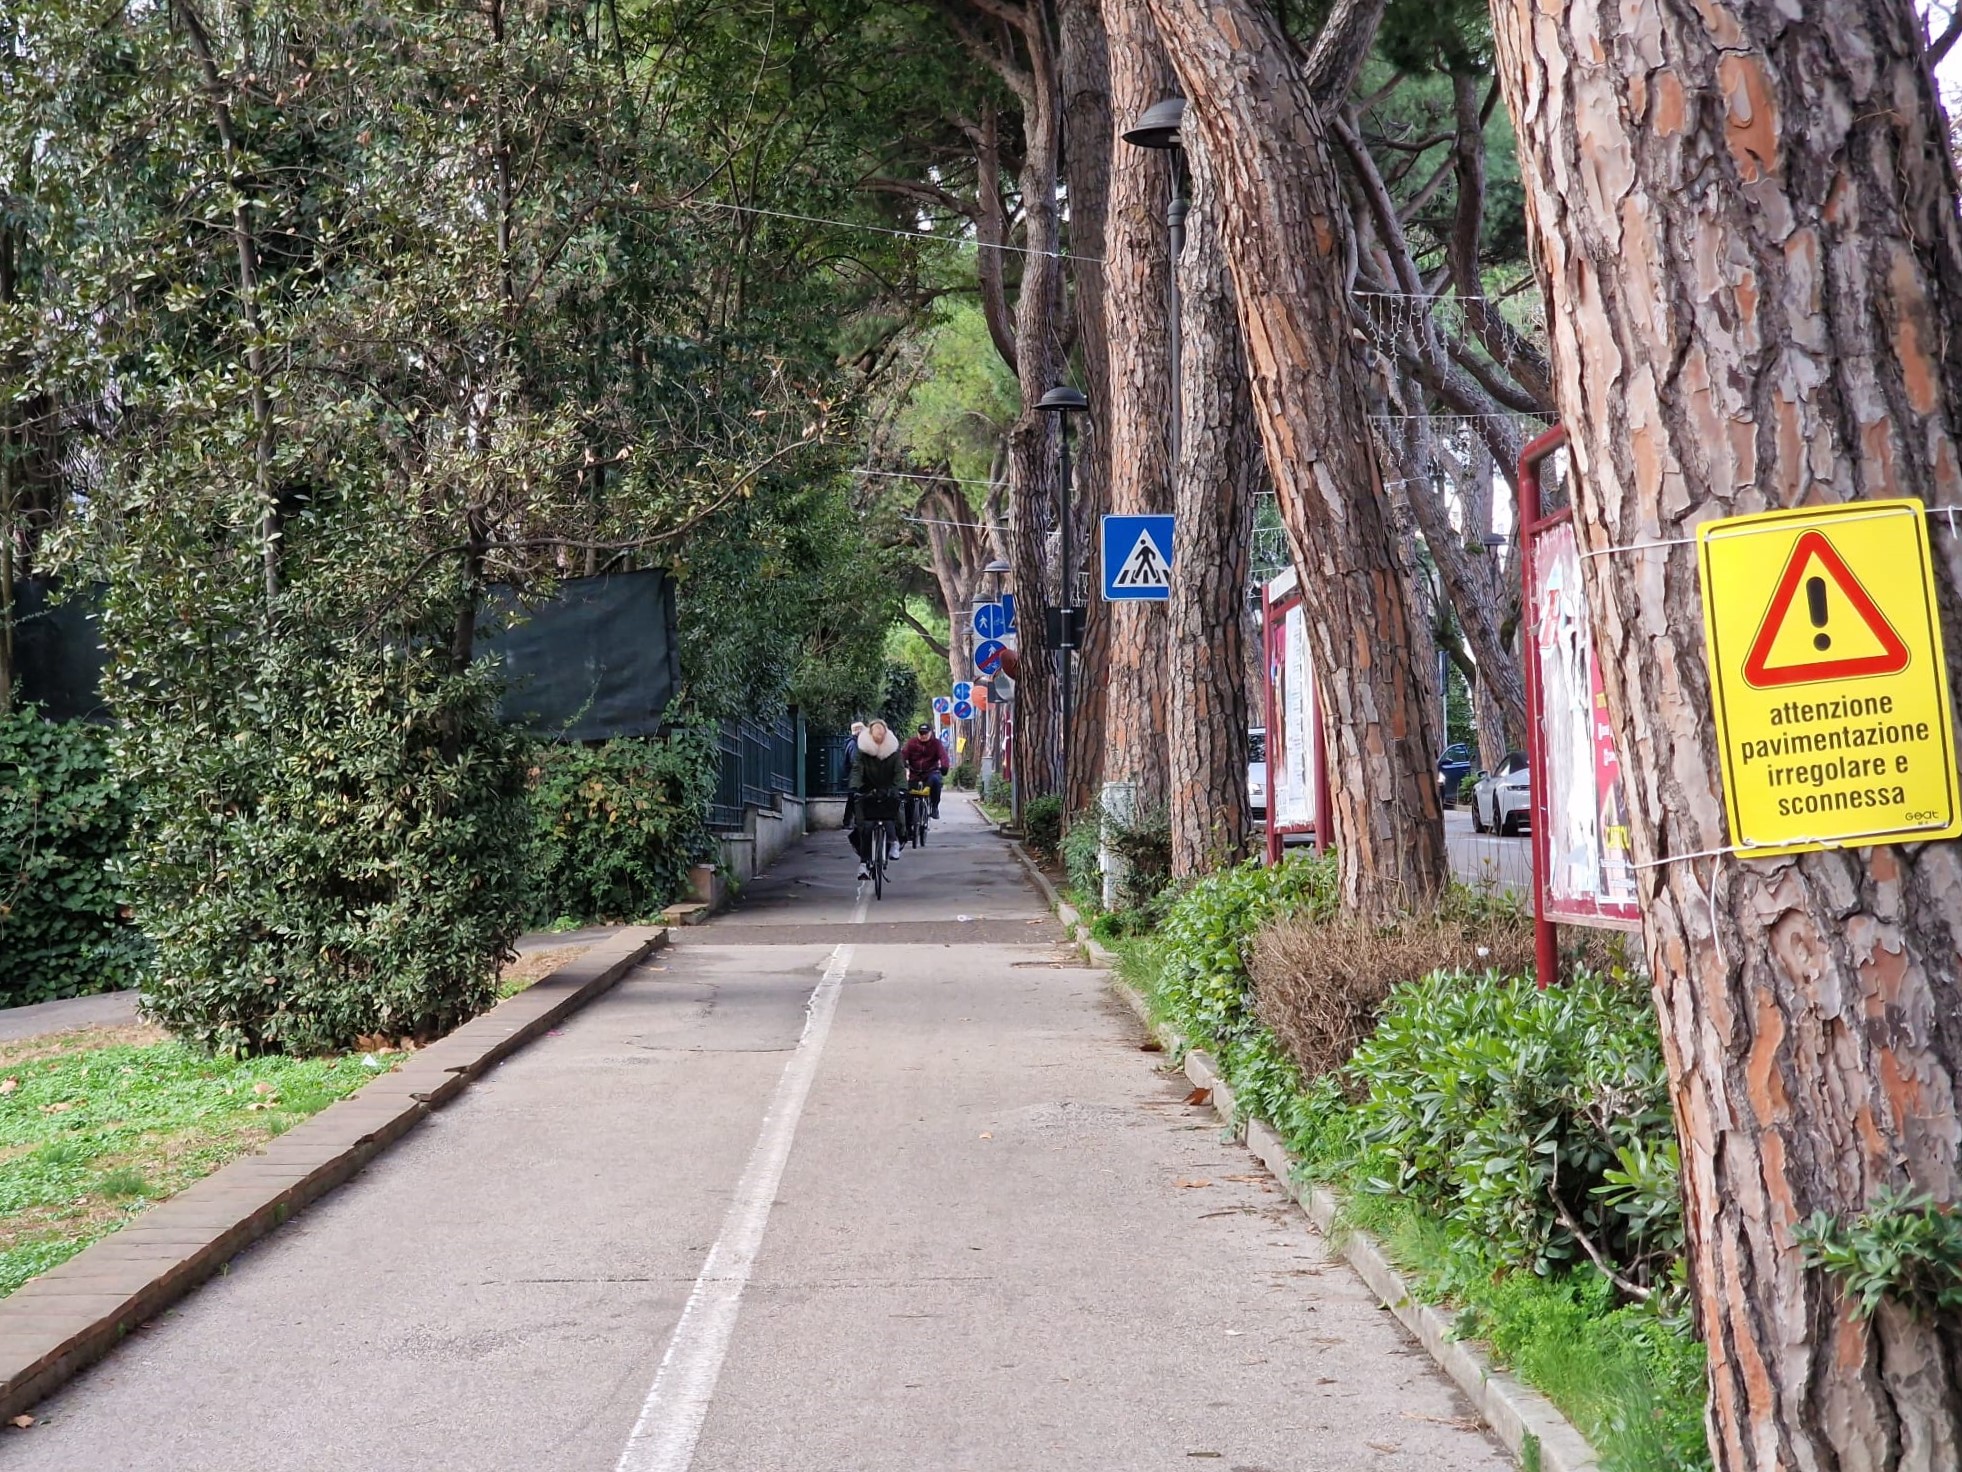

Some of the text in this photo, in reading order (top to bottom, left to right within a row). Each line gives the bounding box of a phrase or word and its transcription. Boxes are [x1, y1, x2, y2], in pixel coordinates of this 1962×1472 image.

[1769, 695, 1893, 726] attenzione
[1741, 722, 1930, 765] pavimentazione
[1767, 754, 1909, 787] irregolare e
[1778, 786, 1906, 816] sconnessa
